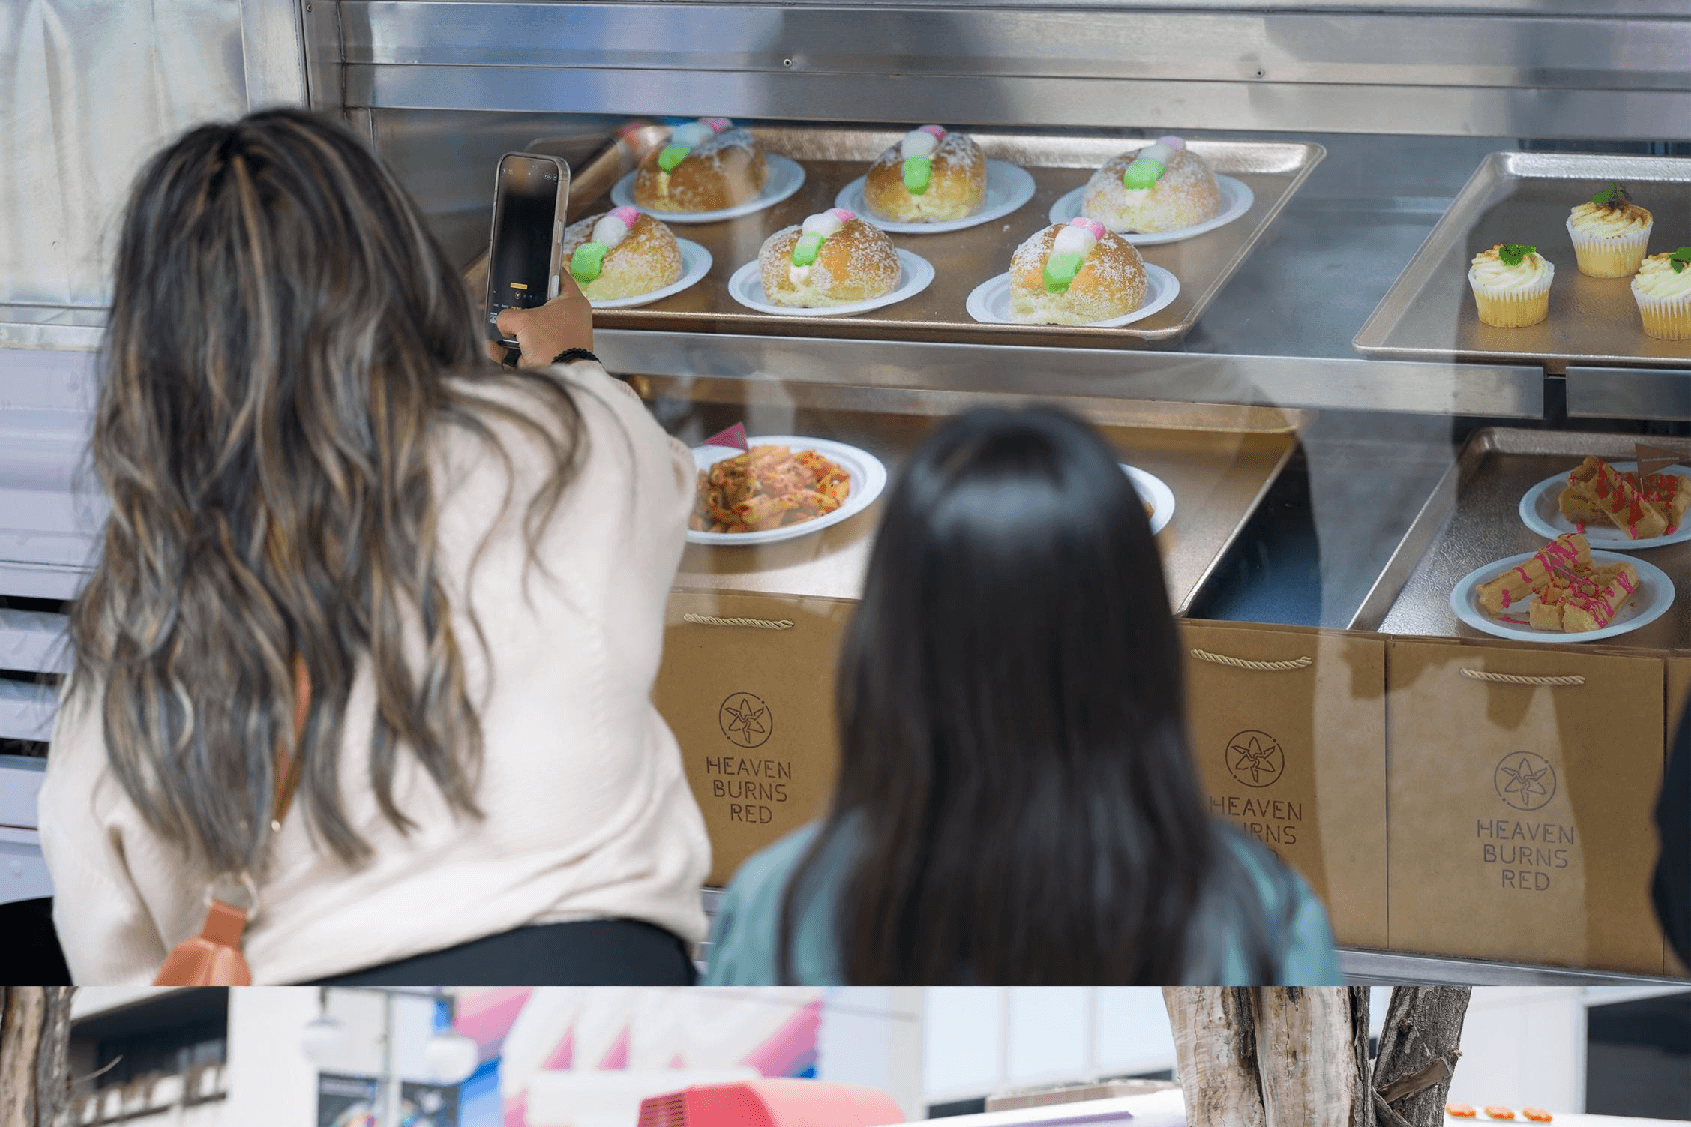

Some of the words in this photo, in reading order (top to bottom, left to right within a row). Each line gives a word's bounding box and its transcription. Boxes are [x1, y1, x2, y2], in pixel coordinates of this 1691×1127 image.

[706, 756, 791, 779] HEAVEN
[713, 779, 787, 802] BURNS
[730, 803, 773, 824] RED
[1209, 795, 1302, 822] HEAVEN
[1243, 822, 1297, 845] RNS
[1476, 819, 1574, 845] HEAVEN
[1483, 843, 1568, 868] BURNS
[1502, 869, 1550, 891] RED
